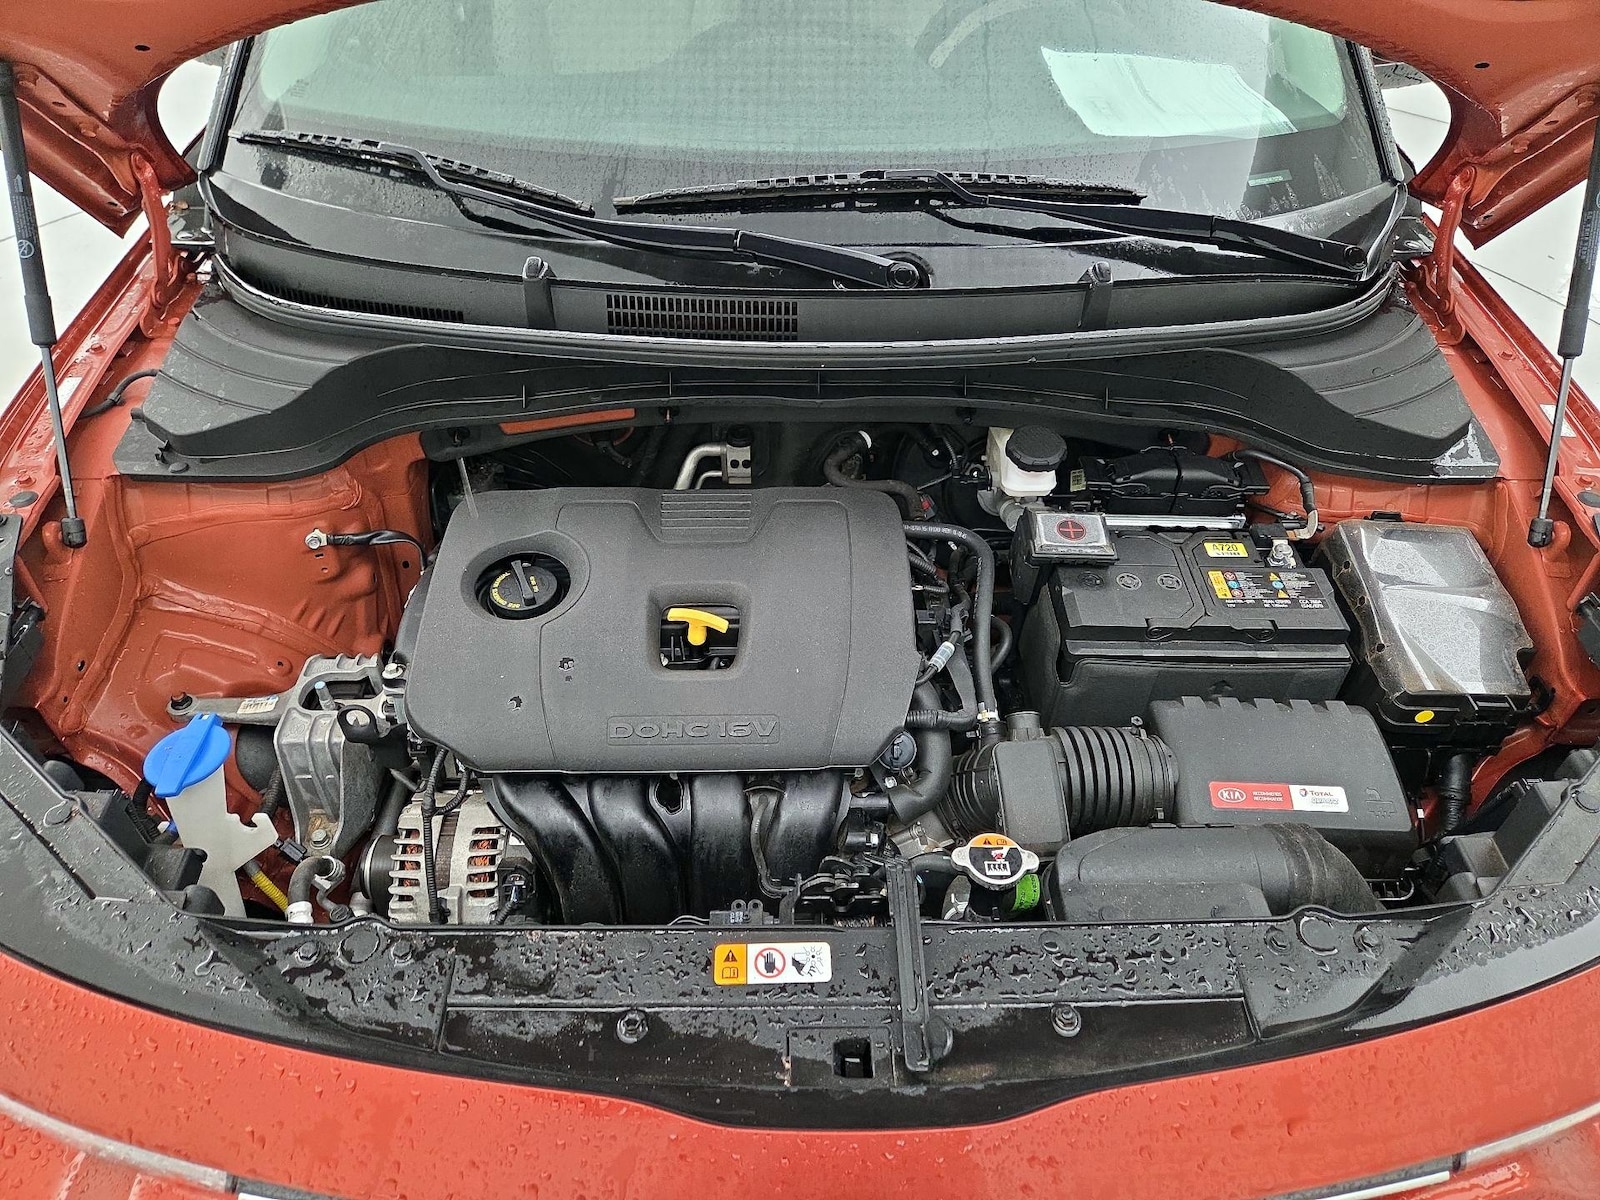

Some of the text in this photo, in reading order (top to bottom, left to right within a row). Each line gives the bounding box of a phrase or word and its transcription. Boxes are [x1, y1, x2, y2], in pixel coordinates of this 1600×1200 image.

[1212, 543, 1239, 552] A720
[609, 720, 778, 739] DOHC 16V
[1222, 790, 1242, 801] KIA
